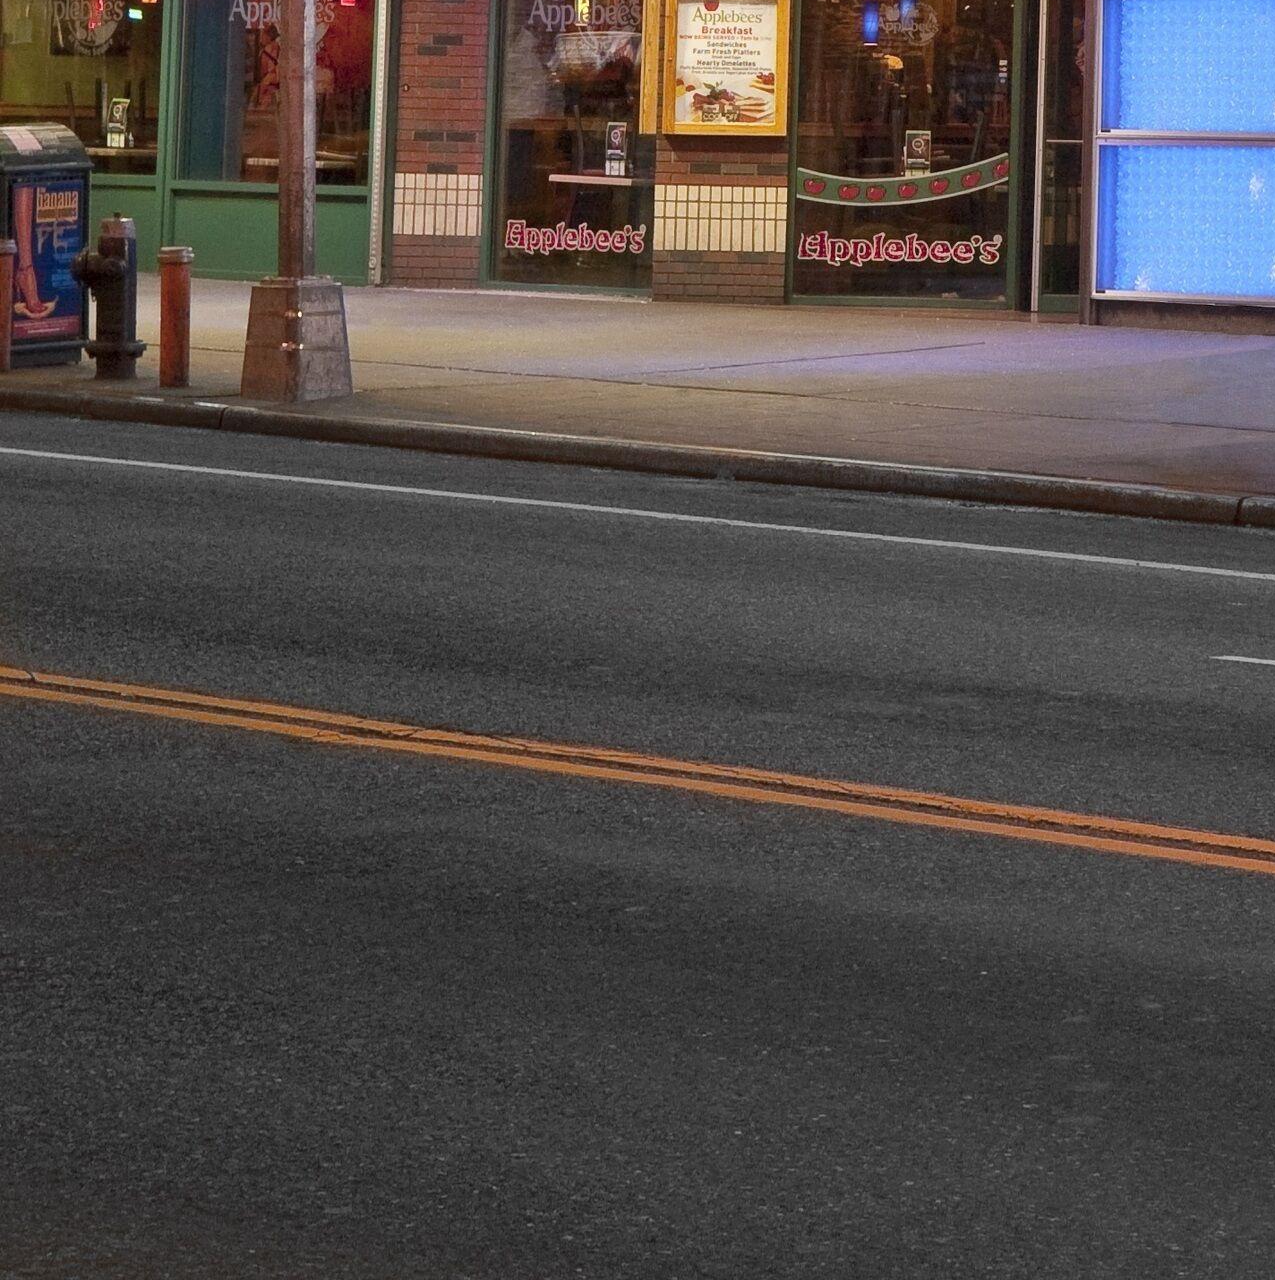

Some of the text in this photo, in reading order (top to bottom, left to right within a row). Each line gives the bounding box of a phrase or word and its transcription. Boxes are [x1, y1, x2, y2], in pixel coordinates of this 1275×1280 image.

[702, 26, 753, 35] Breakfast
[505, 219, 646, 257] Applebee's
[797, 231, 1003, 267] Applebee's
